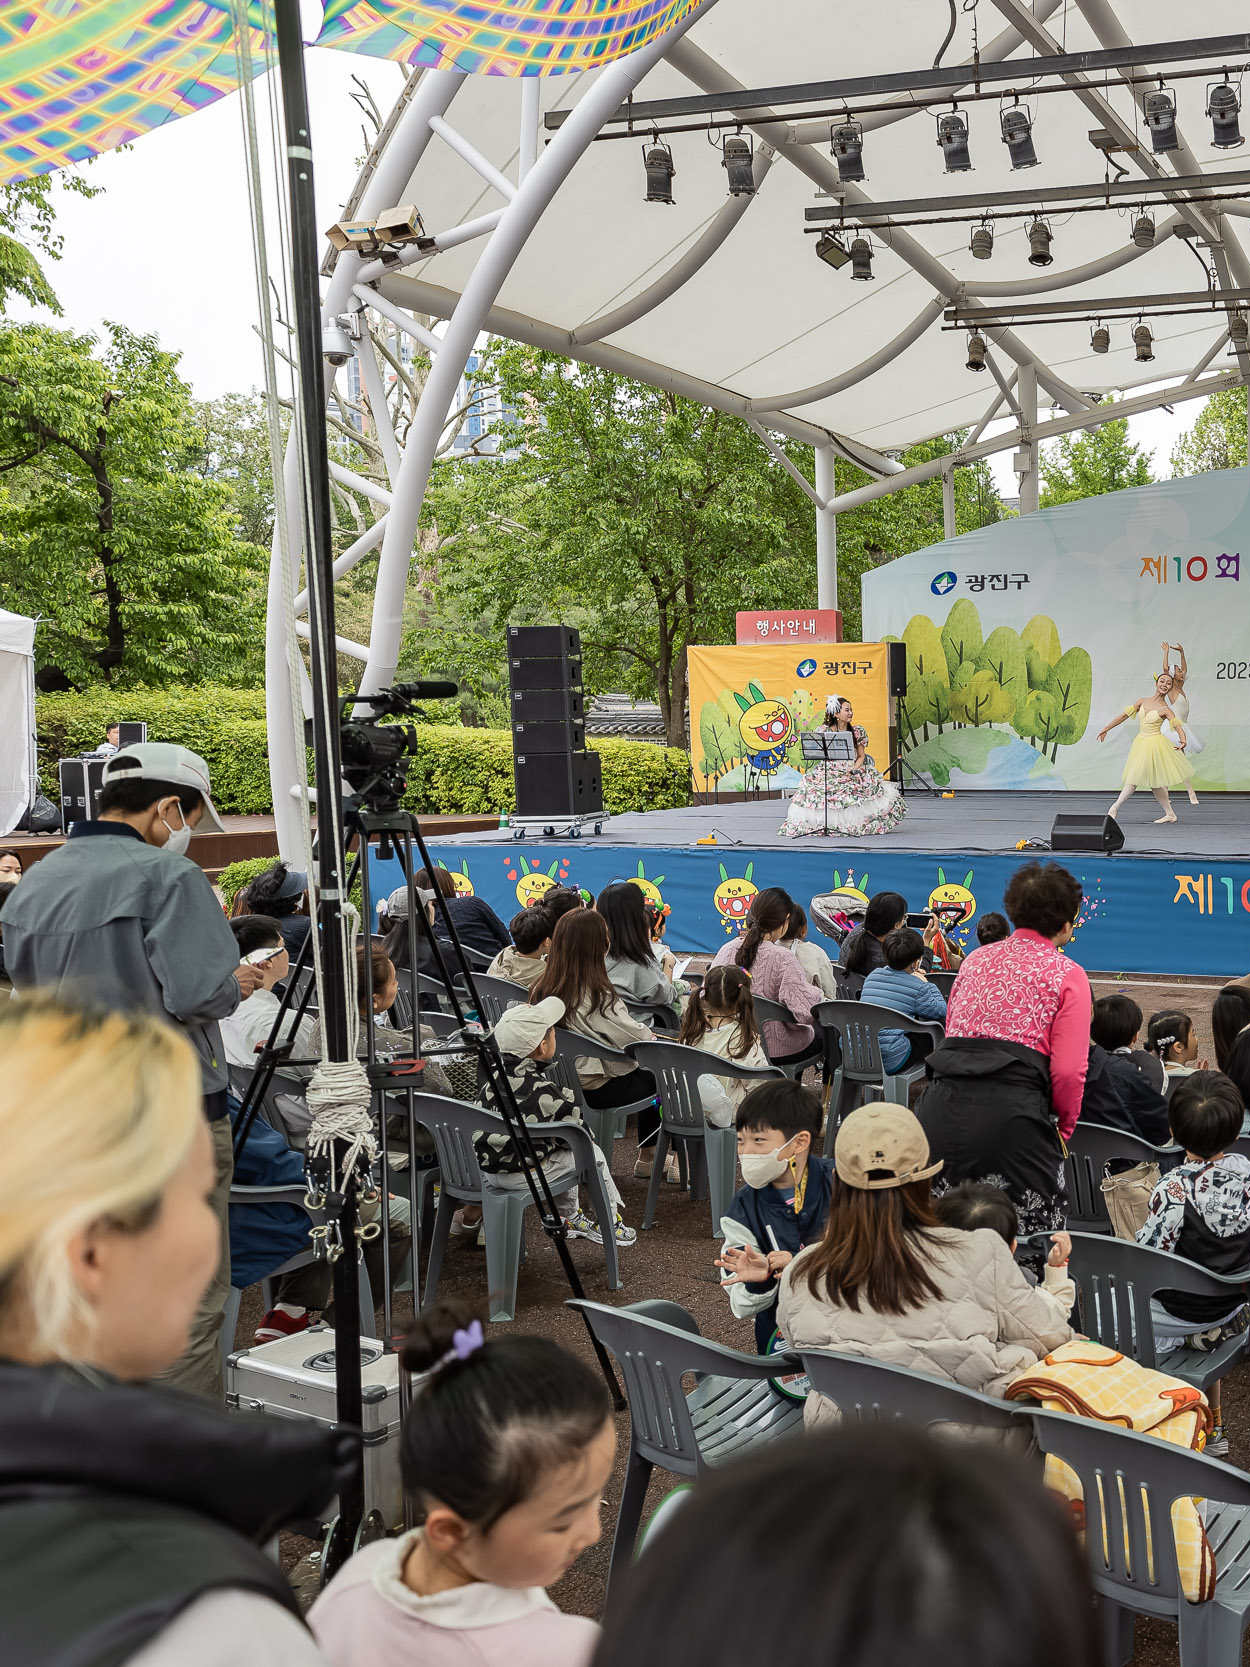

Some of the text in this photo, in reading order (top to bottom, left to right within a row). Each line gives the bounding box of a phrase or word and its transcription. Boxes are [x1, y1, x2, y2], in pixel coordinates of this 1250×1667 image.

[1139, 552, 1240, 584] 제10회
[965, 573, 1031, 592] 광진구
[756, 619, 816, 636] 행사안내
[822, 661, 873, 676] 광진구
